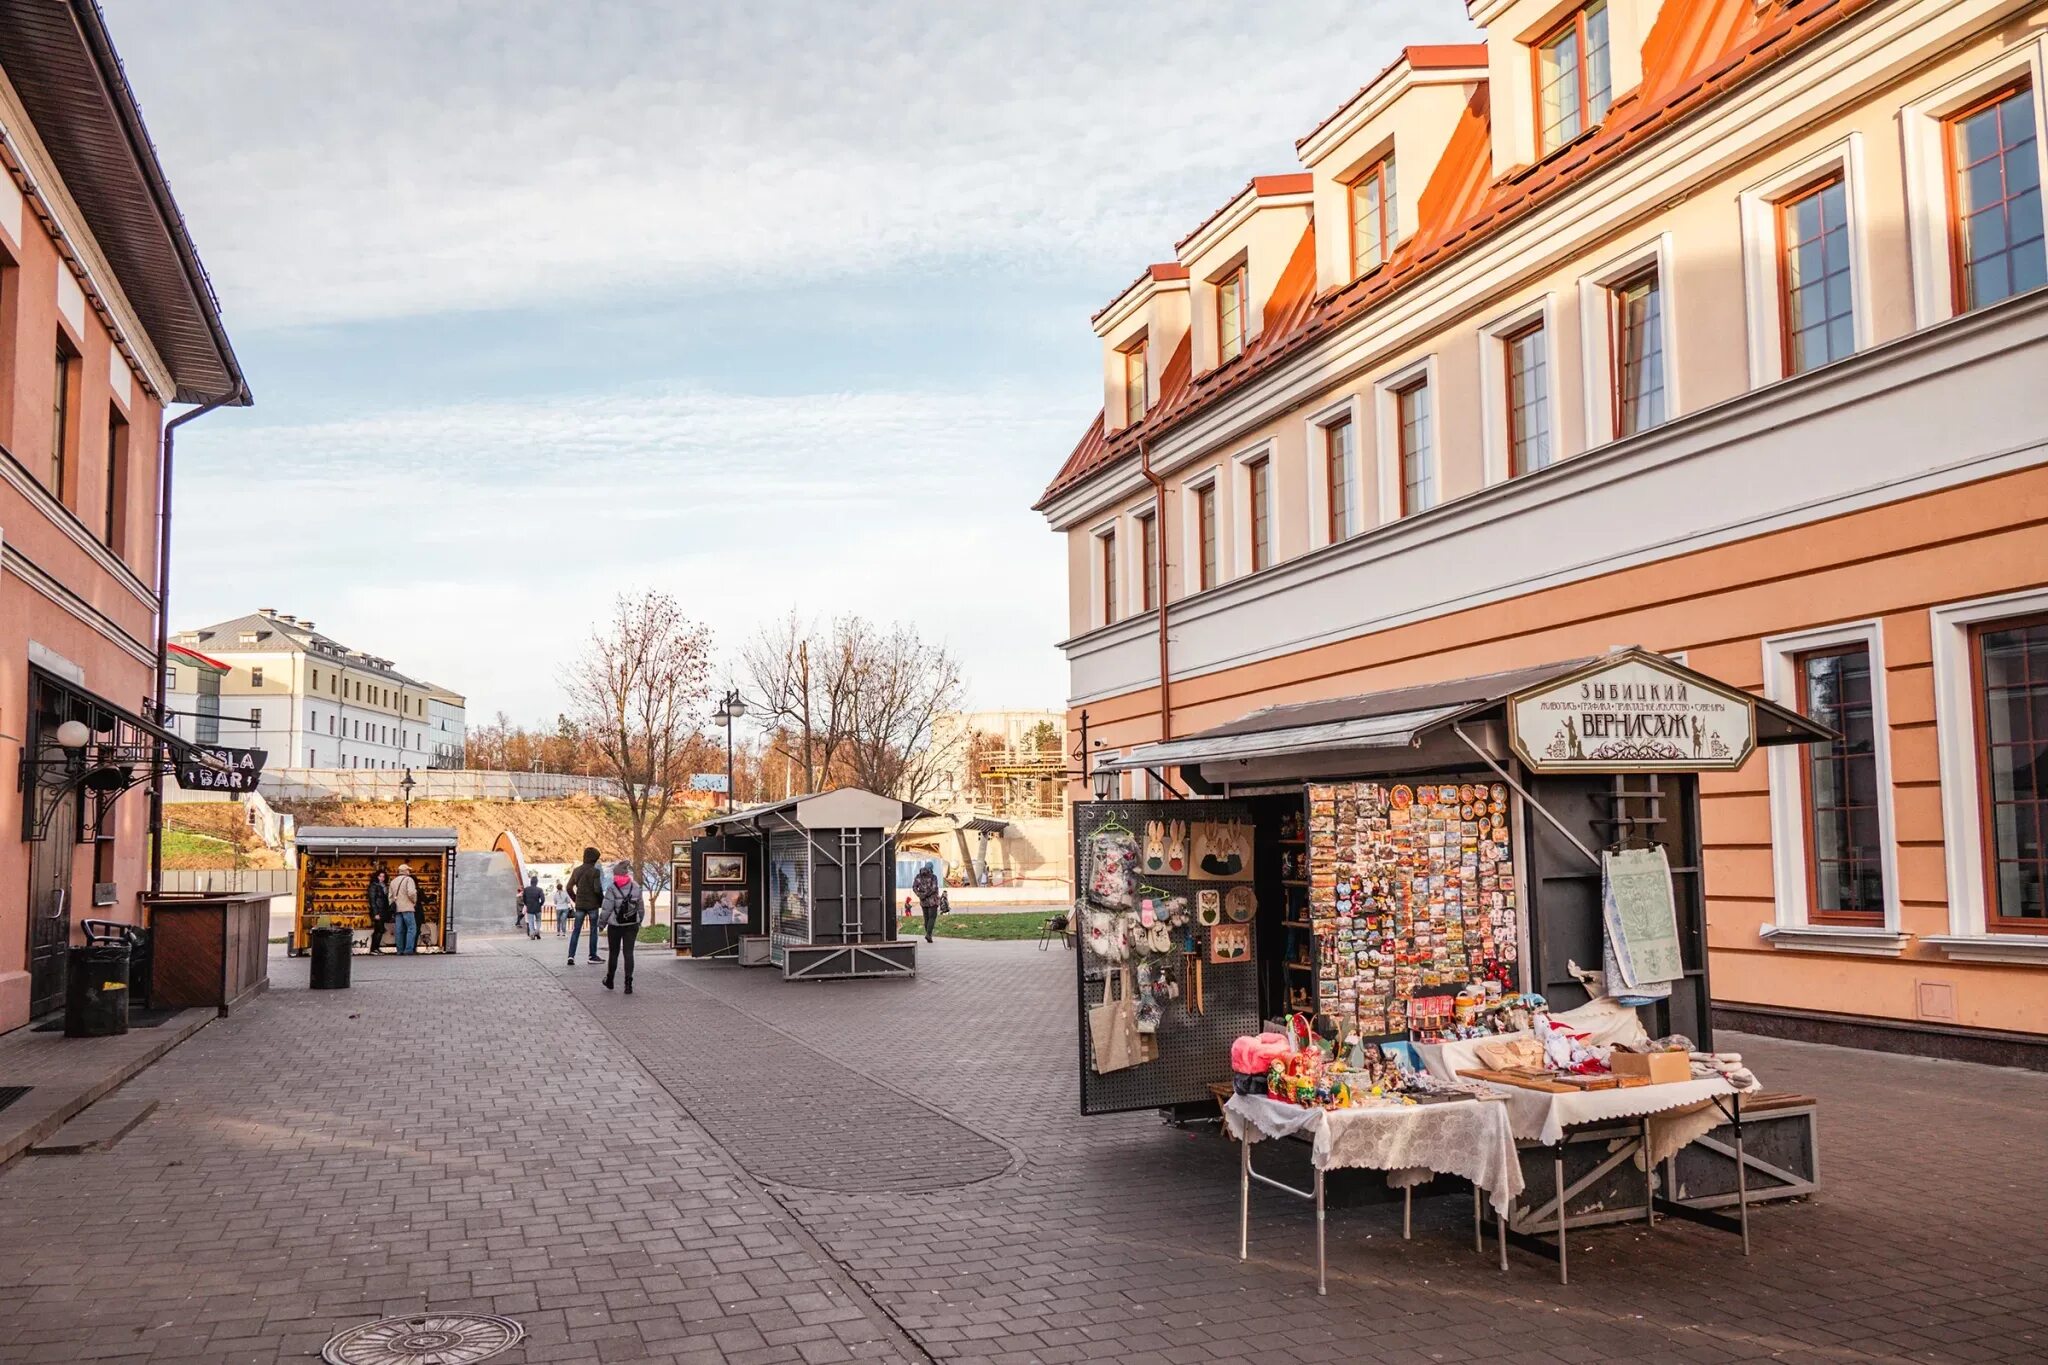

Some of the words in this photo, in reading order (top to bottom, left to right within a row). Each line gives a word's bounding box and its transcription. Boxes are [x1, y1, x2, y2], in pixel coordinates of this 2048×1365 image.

[1581, 683, 1688, 700] ЗЫБИЦКИЙ
[1581, 702, 1612, 711] ГРАФИКА
[1581, 713, 1689, 738] ВЕРНИСАЖ
[189, 750, 255, 769] SLA
[200, 769, 242, 788] BAR
